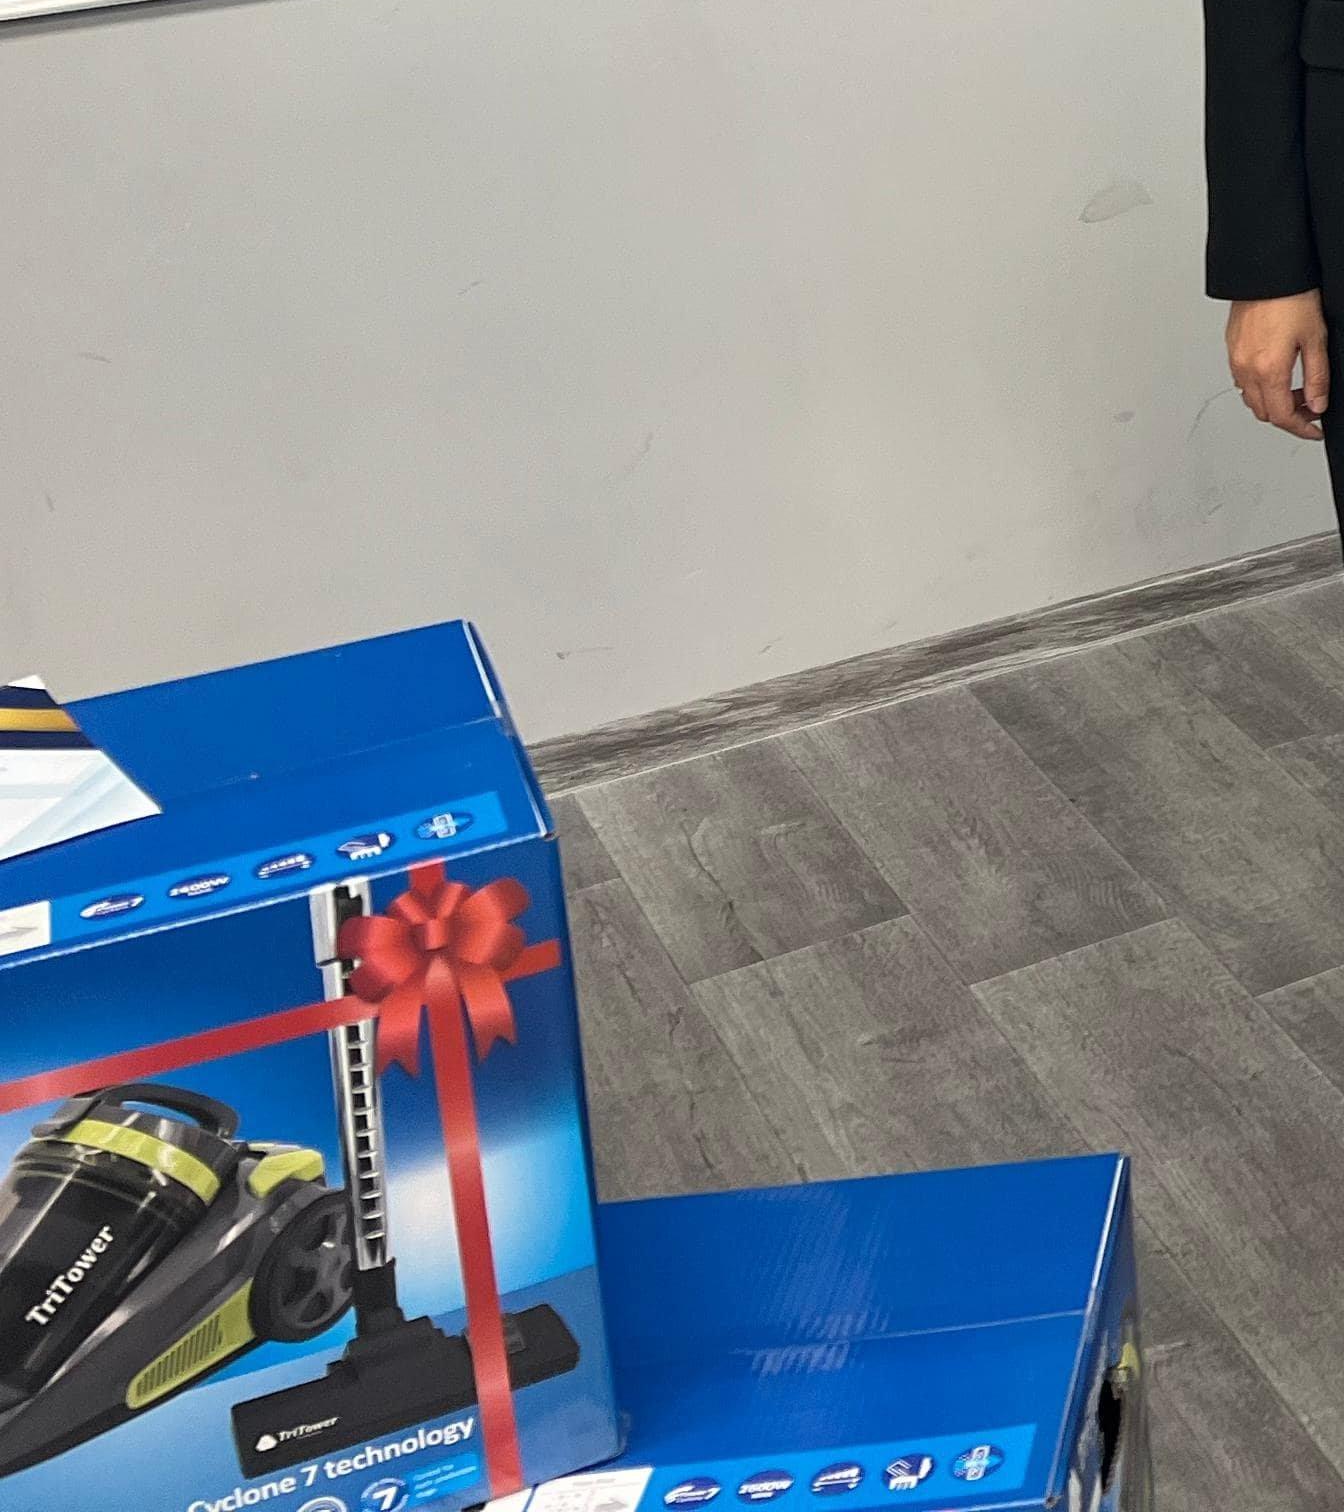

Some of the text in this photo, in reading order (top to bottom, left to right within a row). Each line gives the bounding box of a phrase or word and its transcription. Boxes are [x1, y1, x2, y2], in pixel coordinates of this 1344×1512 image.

[25, 1223, 117, 1327] TriTower
[187, 1416, 474, 1512] Cyclone 7 technology
[278, 1416, 341, 1442] TriTower
